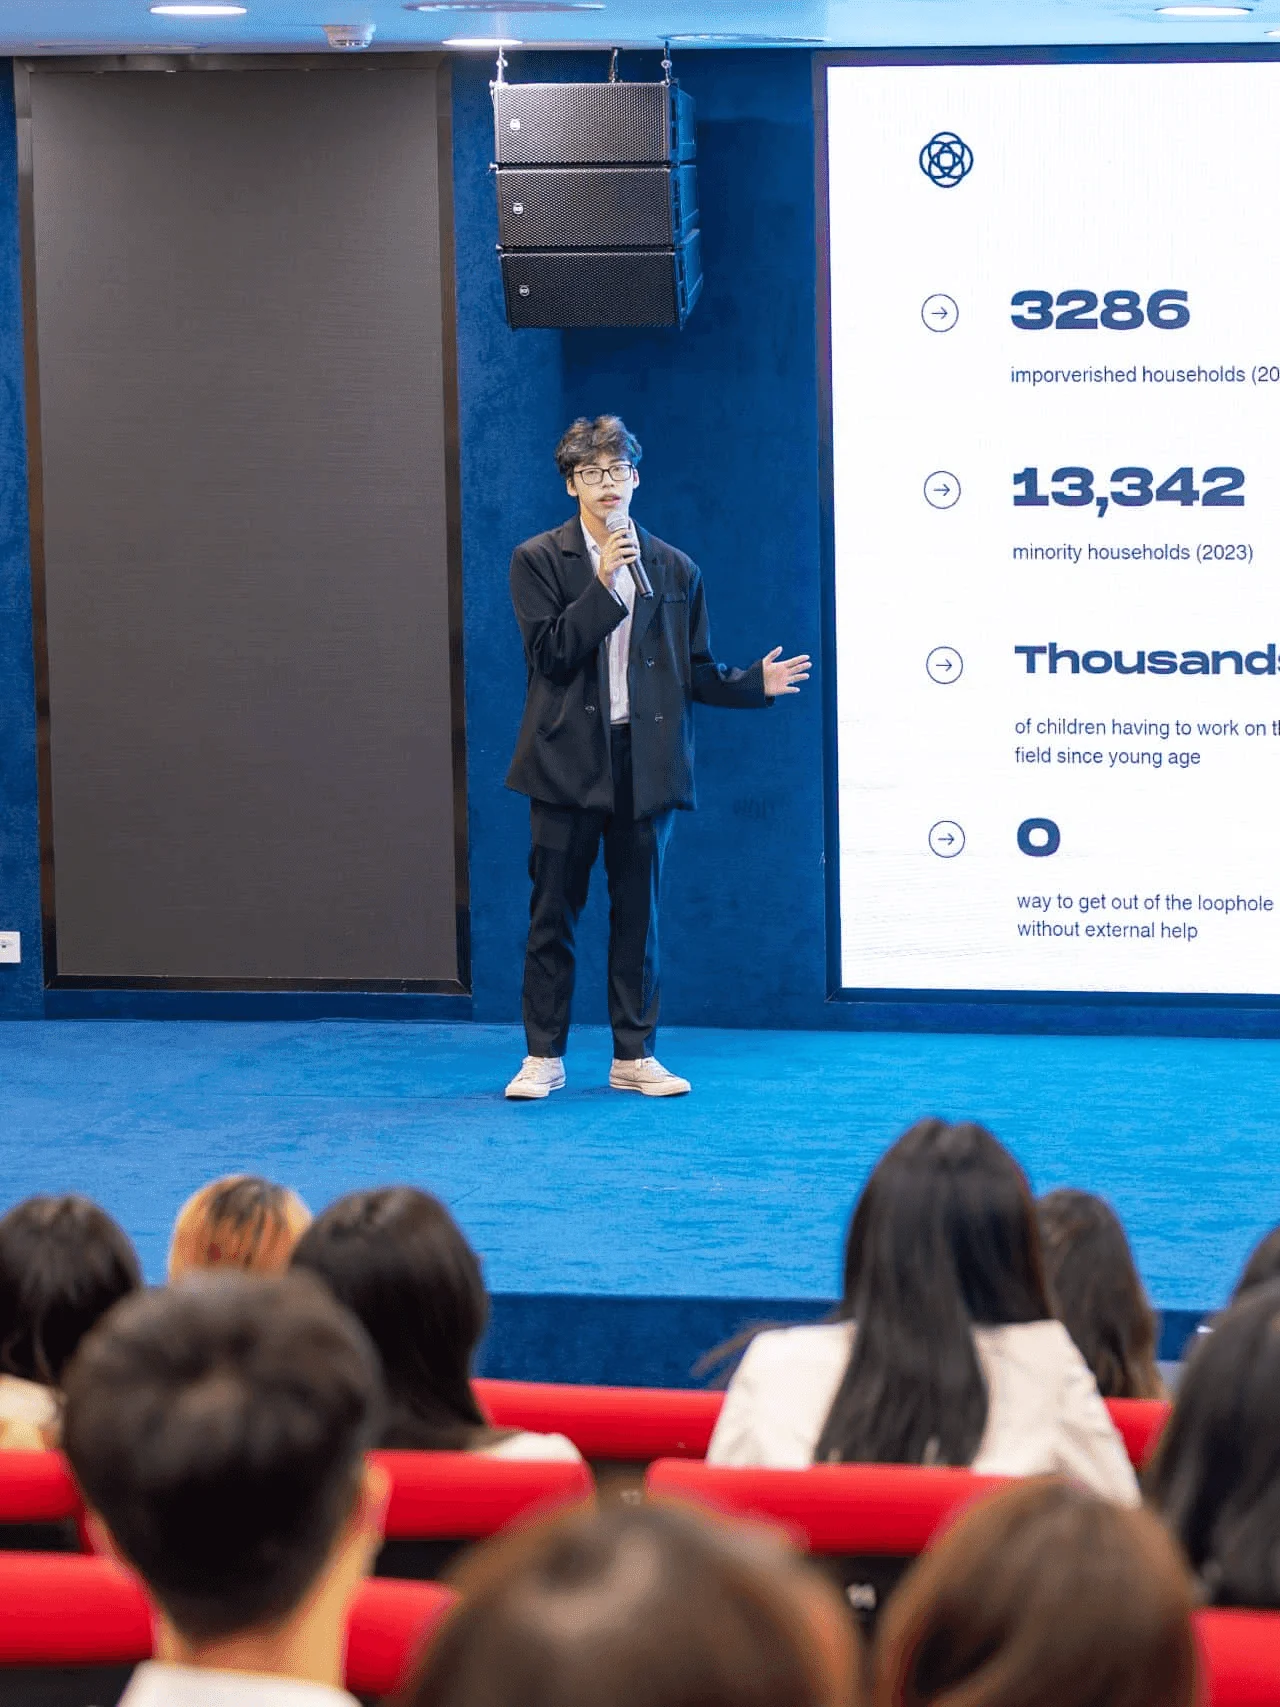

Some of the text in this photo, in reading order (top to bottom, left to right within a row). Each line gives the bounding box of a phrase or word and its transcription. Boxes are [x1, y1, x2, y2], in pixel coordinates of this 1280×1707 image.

[1010, 288, 1191, 331] 3286
[1011, 364, 1137, 387] imporverished
[1142, 364, 1246, 383] households
[1012, 465, 1246, 519] 13,342
[1012, 542, 1254, 565] minority households (2023)
[1015, 717, 1032, 735] of
[1036, 717, 1106, 736] children
[1111, 718, 1170, 741] having
[1175, 719, 1192, 736] to
[1196, 719, 1239, 737] work
[1244, 723, 1267, 737] on
[1015, 745, 1201, 769] field since young age
[1016, 892, 1274, 916] way to get out of the loophole
[1017, 919, 1198, 943] without external help
